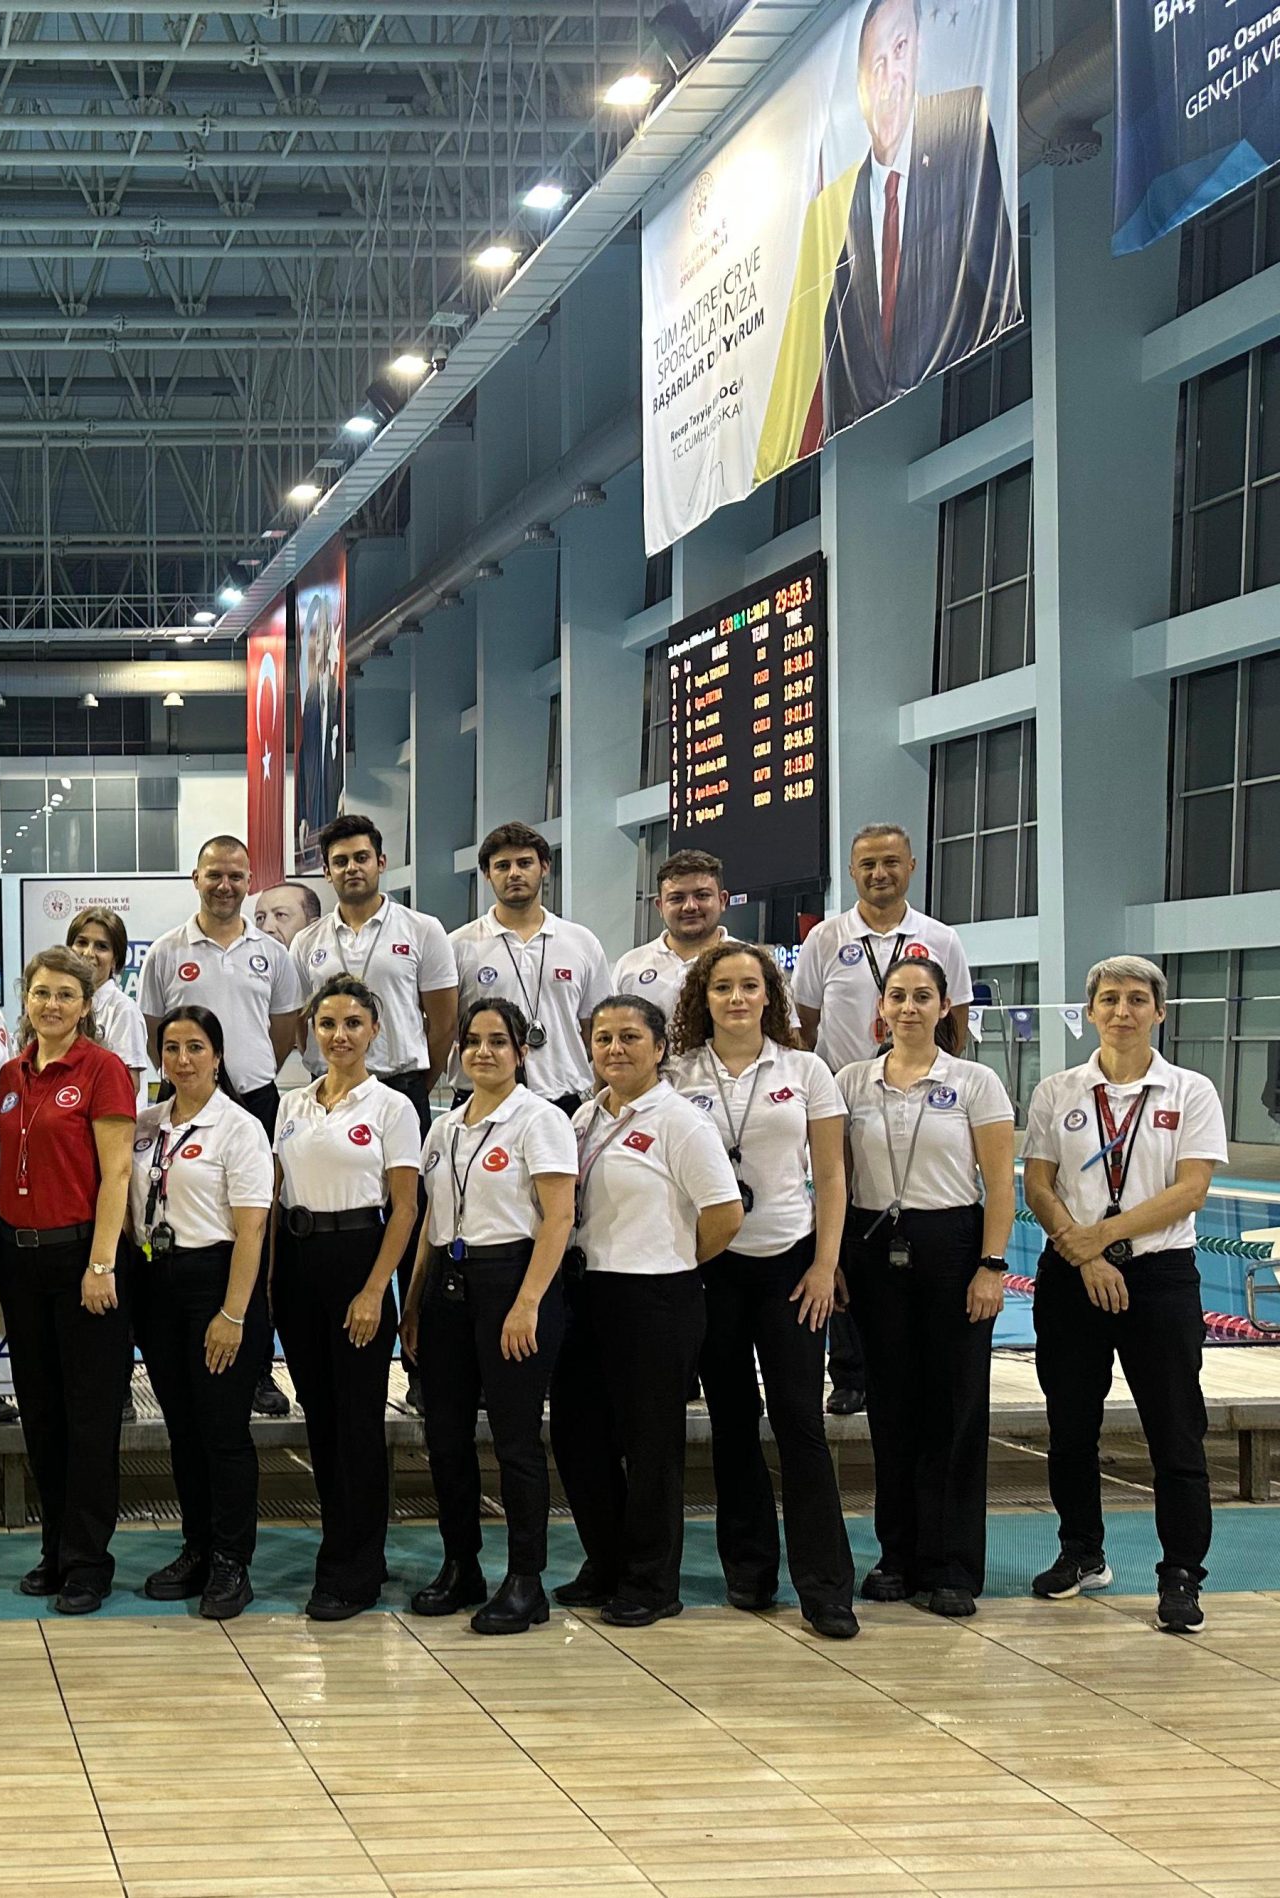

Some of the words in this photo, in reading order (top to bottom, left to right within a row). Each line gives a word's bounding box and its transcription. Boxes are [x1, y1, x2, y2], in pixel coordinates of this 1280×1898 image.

[1207, 44, 1231, 71] Dr.
[1185, 51, 1259, 119] GENÇLİK
[654, 321, 678, 360] TÜM
[744, 246, 761, 278] VE
[653, 358, 705, 415] BAŞARILAR
[670, 420, 689, 444] Recep
[689, 403, 712, 430] Tayyip
[672, 447, 684, 462] T.C.
[775, 576, 812, 614] 29:55.3
[751, 622, 769, 643] TEAM
[786, 607, 802, 628] TIME
[672, 682, 678, 699] 1
[672, 704, 678, 721] 2
[672, 747, 678, 765] 4
[784, 700, 814, 726] 19:01.11
[672, 726, 678, 744] 3
[672, 769, 678, 787] 5
[686, 764, 692, 783] 7
[672, 791, 678, 809] 6
[686, 787, 692, 806] 5
[672, 813, 678, 831] 7
[686, 810, 692, 828] 2
[89, 897, 118, 905] GENÇLİK
